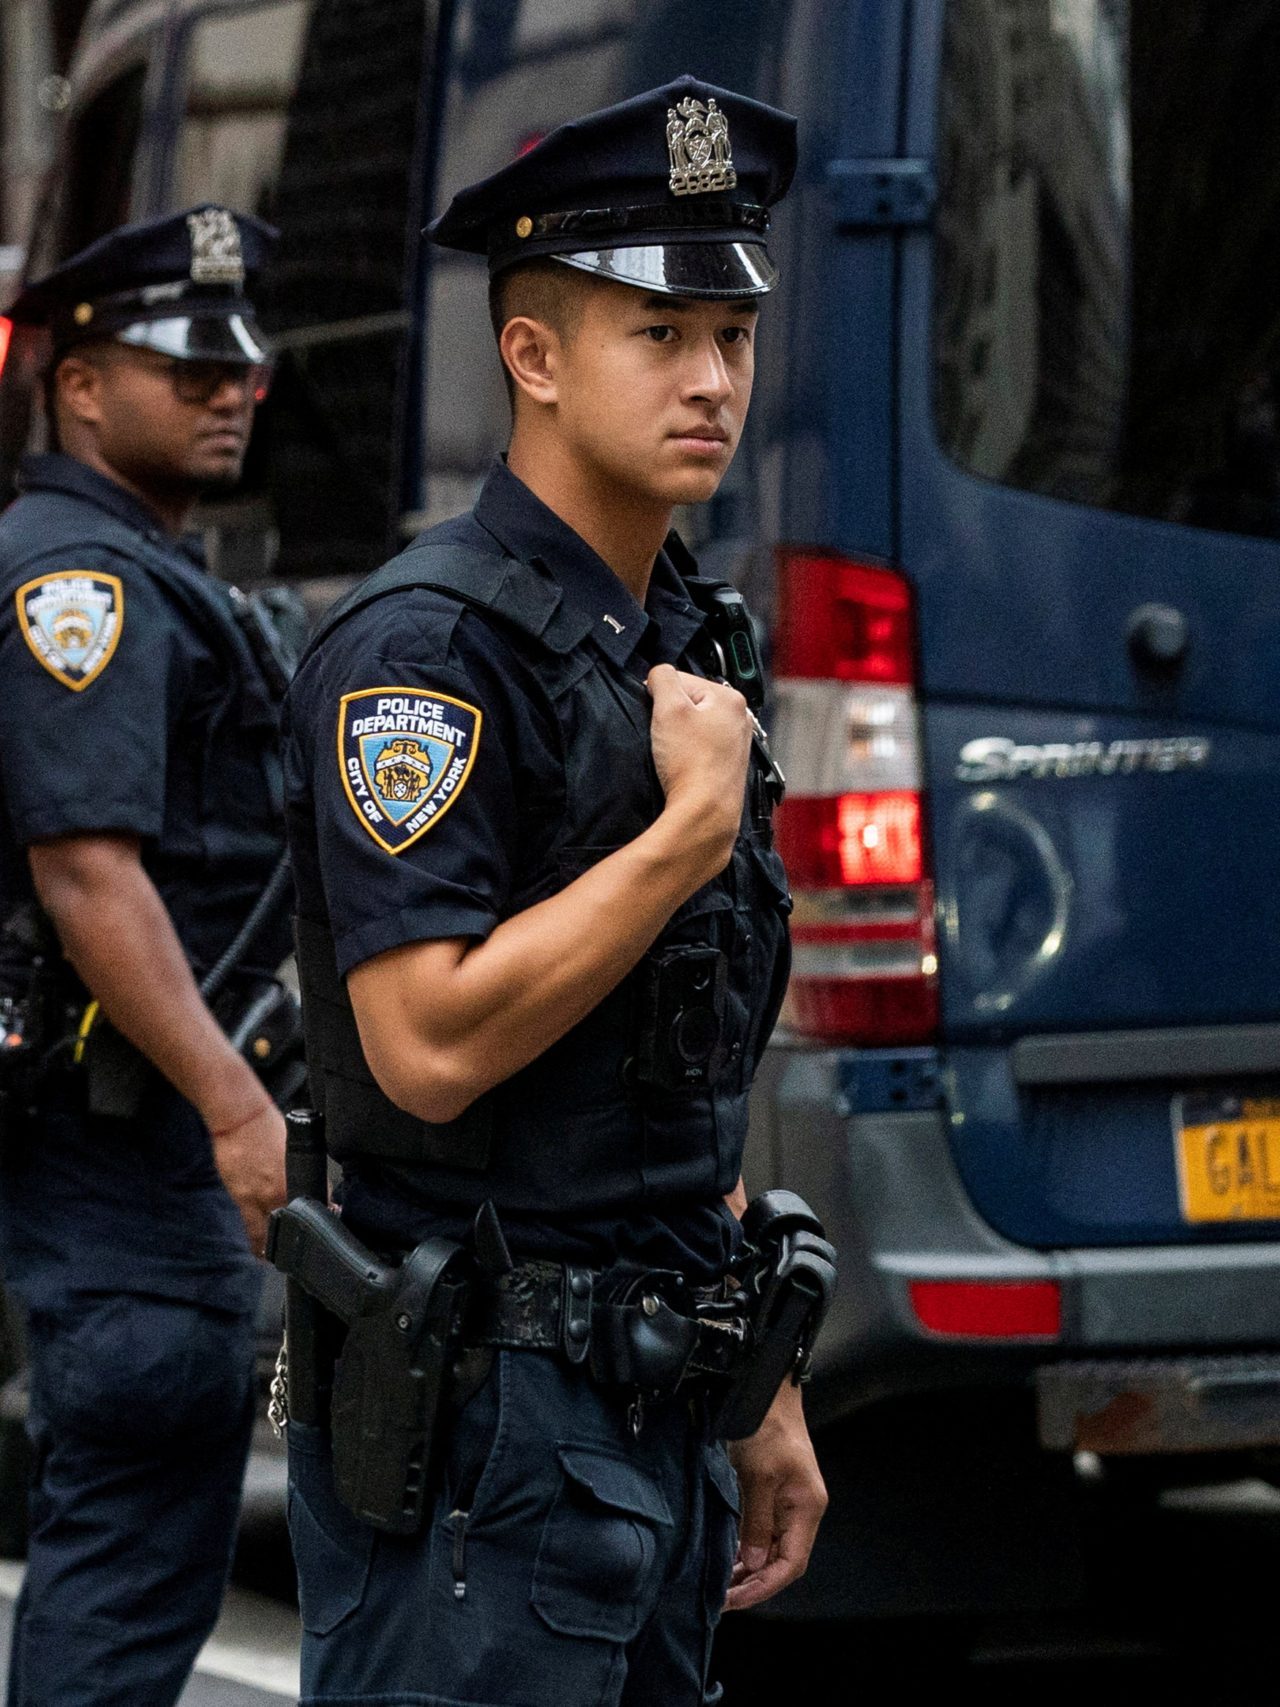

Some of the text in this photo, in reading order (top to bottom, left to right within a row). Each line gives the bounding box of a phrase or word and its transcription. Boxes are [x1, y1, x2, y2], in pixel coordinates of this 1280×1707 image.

[351, 715, 466, 747] DEPARTMENT
[377, 698, 444, 721] POLICE
[347, 757, 384, 824] CITY OF
[405, 756, 468, 834] NEW YORK
